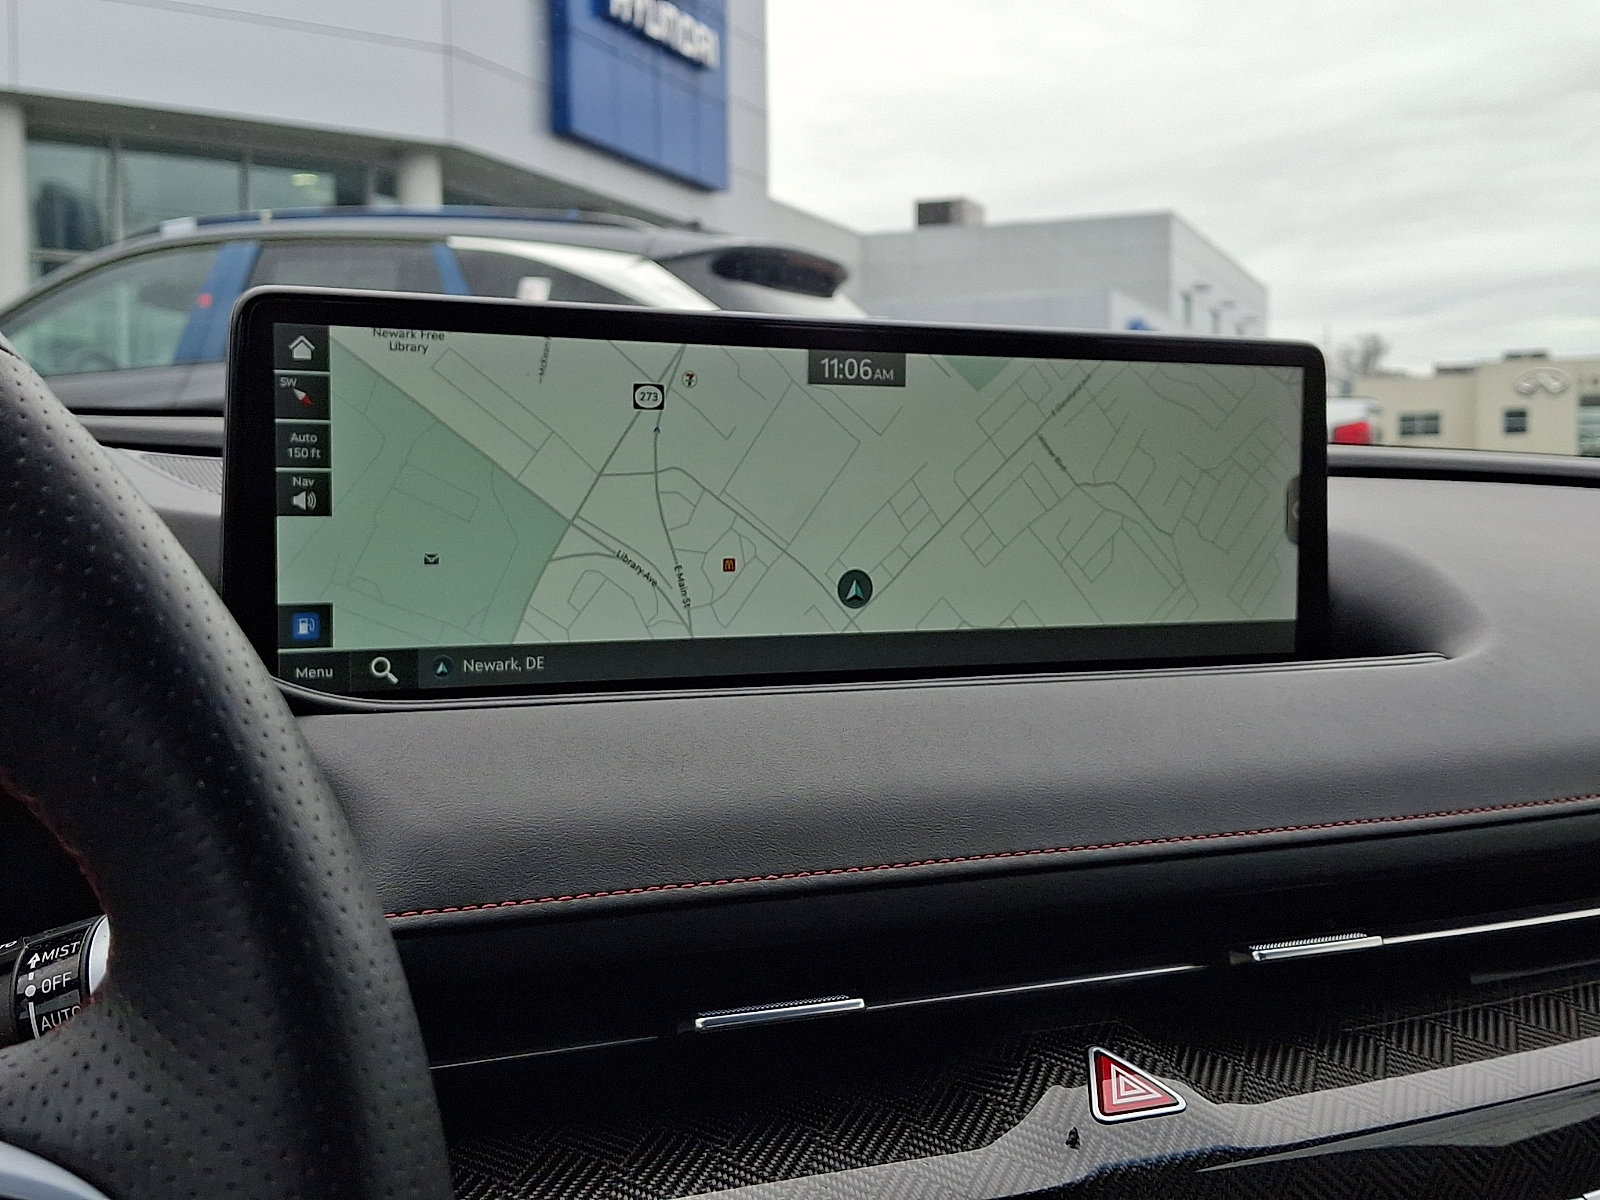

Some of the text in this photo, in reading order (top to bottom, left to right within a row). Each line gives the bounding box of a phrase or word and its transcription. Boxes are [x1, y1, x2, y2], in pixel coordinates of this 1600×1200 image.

[373, 328, 445, 341] Newark Free
[389, 341, 429, 354] Library
[821, 358, 894, 380] 11:06 AM
[280, 377, 298, 387] SW
[639, 391, 659, 402] 273
[290, 432, 318, 443] Auto
[288, 448, 321, 459] 150 ft
[292, 477, 315, 487] Nav
[616, 550, 658, 587] Library Ave
[676, 573, 688, 599] Main
[463, 656, 545, 672] Newark, DE
[296, 667, 333, 679] Menu
[41, 941, 80, 963] MIST
[41, 972, 72, 993] OFF
